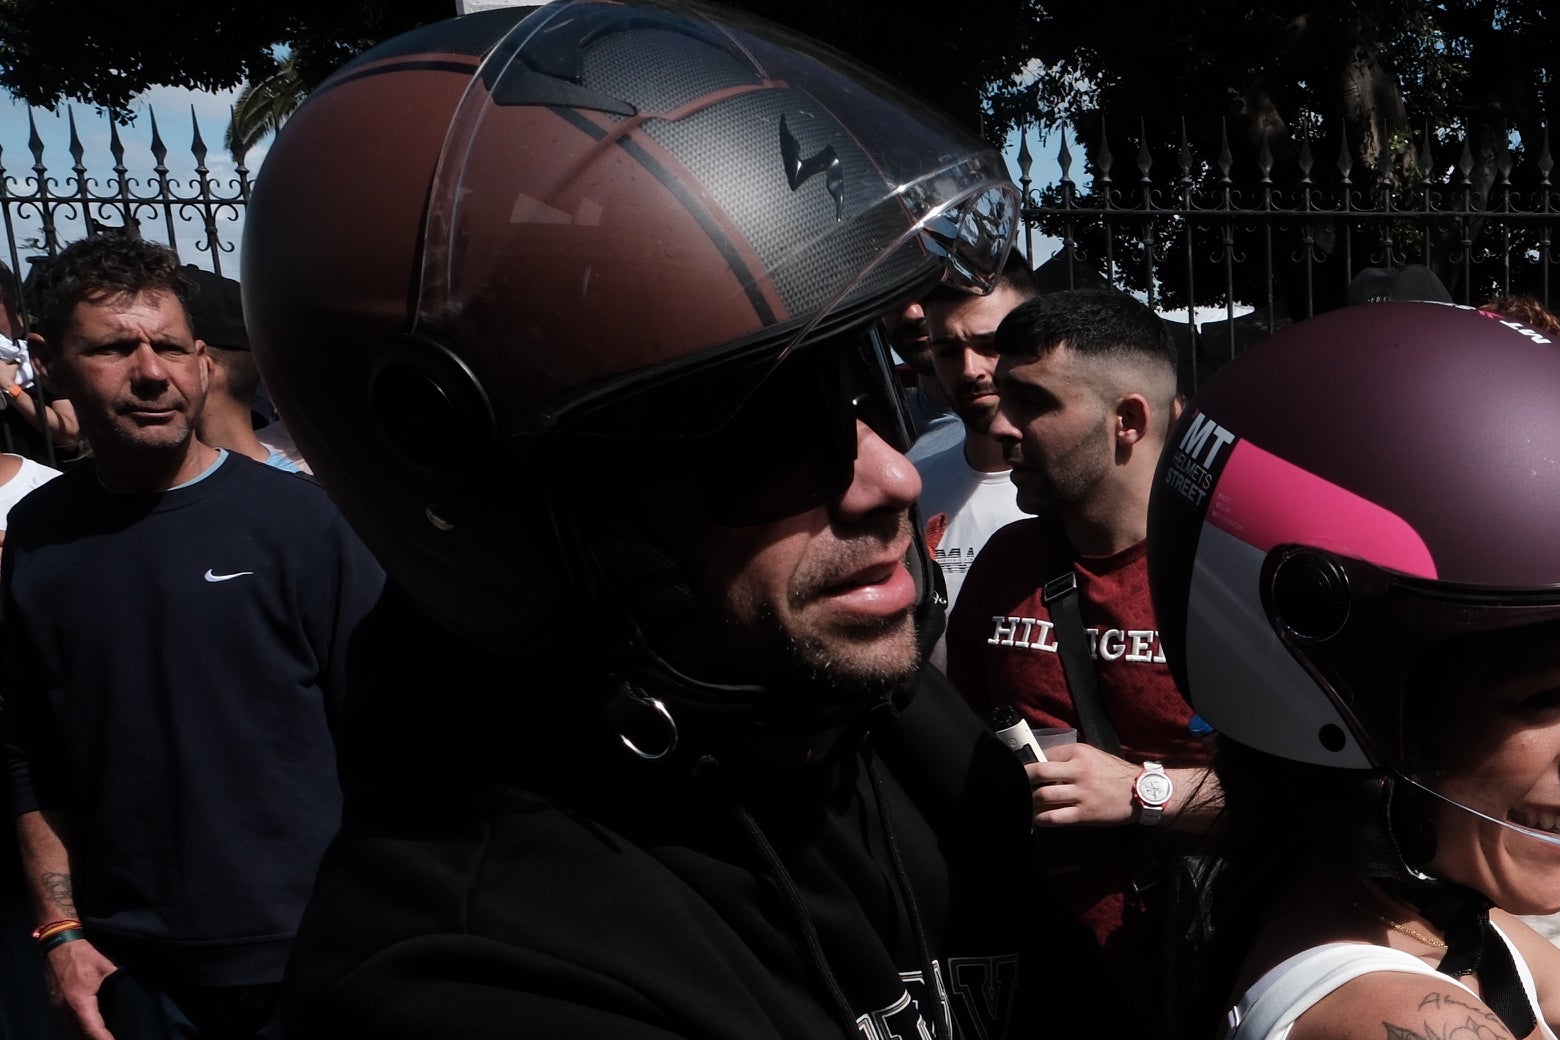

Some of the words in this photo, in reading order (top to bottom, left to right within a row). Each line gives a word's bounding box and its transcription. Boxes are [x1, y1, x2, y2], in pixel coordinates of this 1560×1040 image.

[1179, 412, 1236, 470] MT
[1165, 467, 1207, 507] STREET
[1174, 451, 1213, 490] HELMETS
